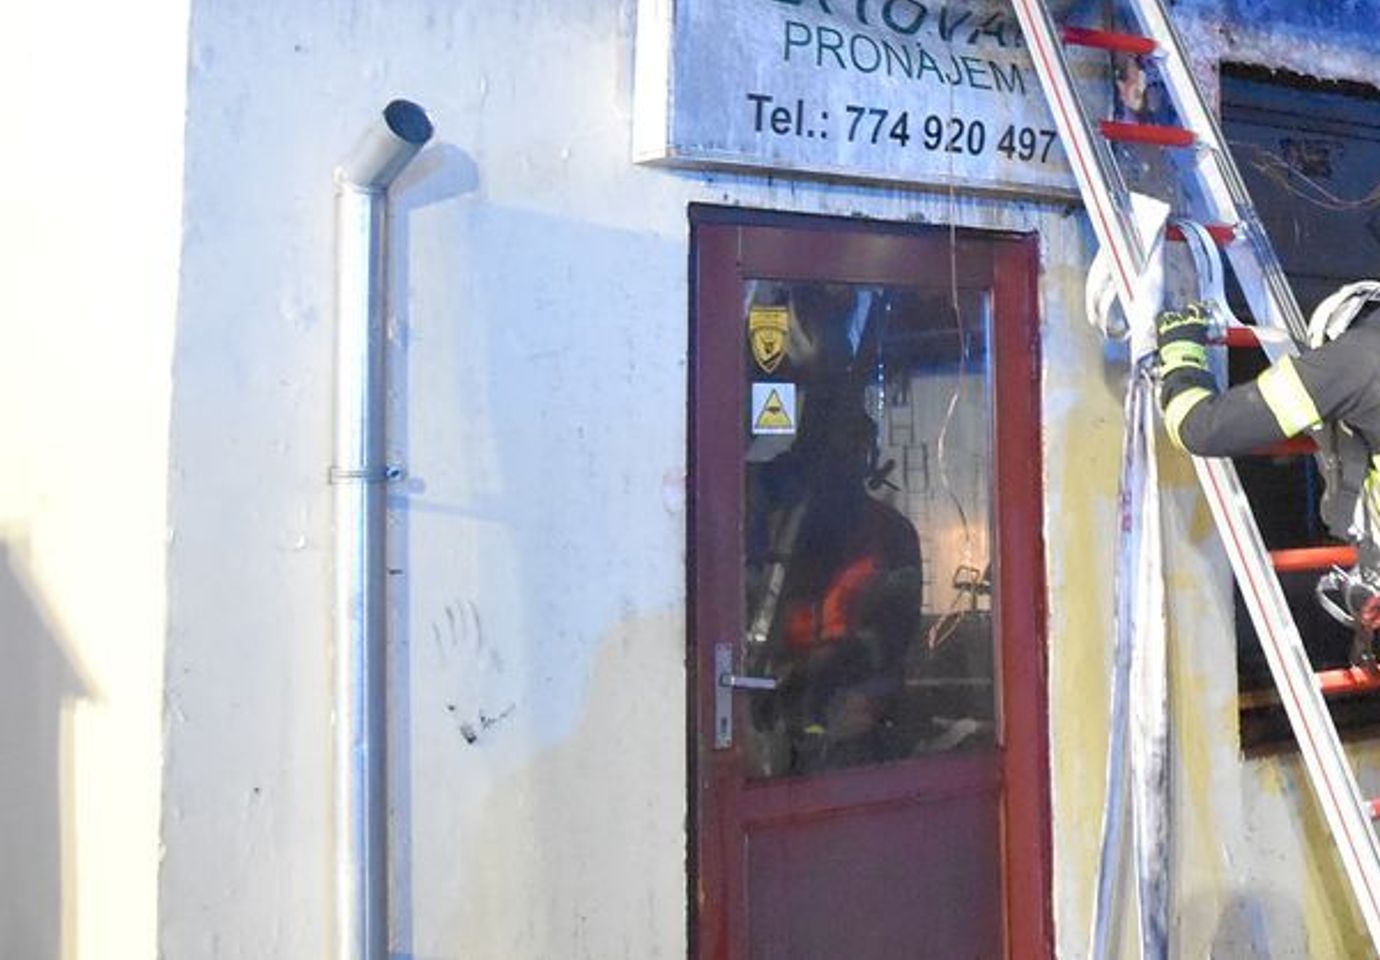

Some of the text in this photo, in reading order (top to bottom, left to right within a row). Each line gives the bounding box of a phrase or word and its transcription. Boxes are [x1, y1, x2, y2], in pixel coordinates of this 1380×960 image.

[747, 93, 1057, 163] Tel.: 774 920 497
